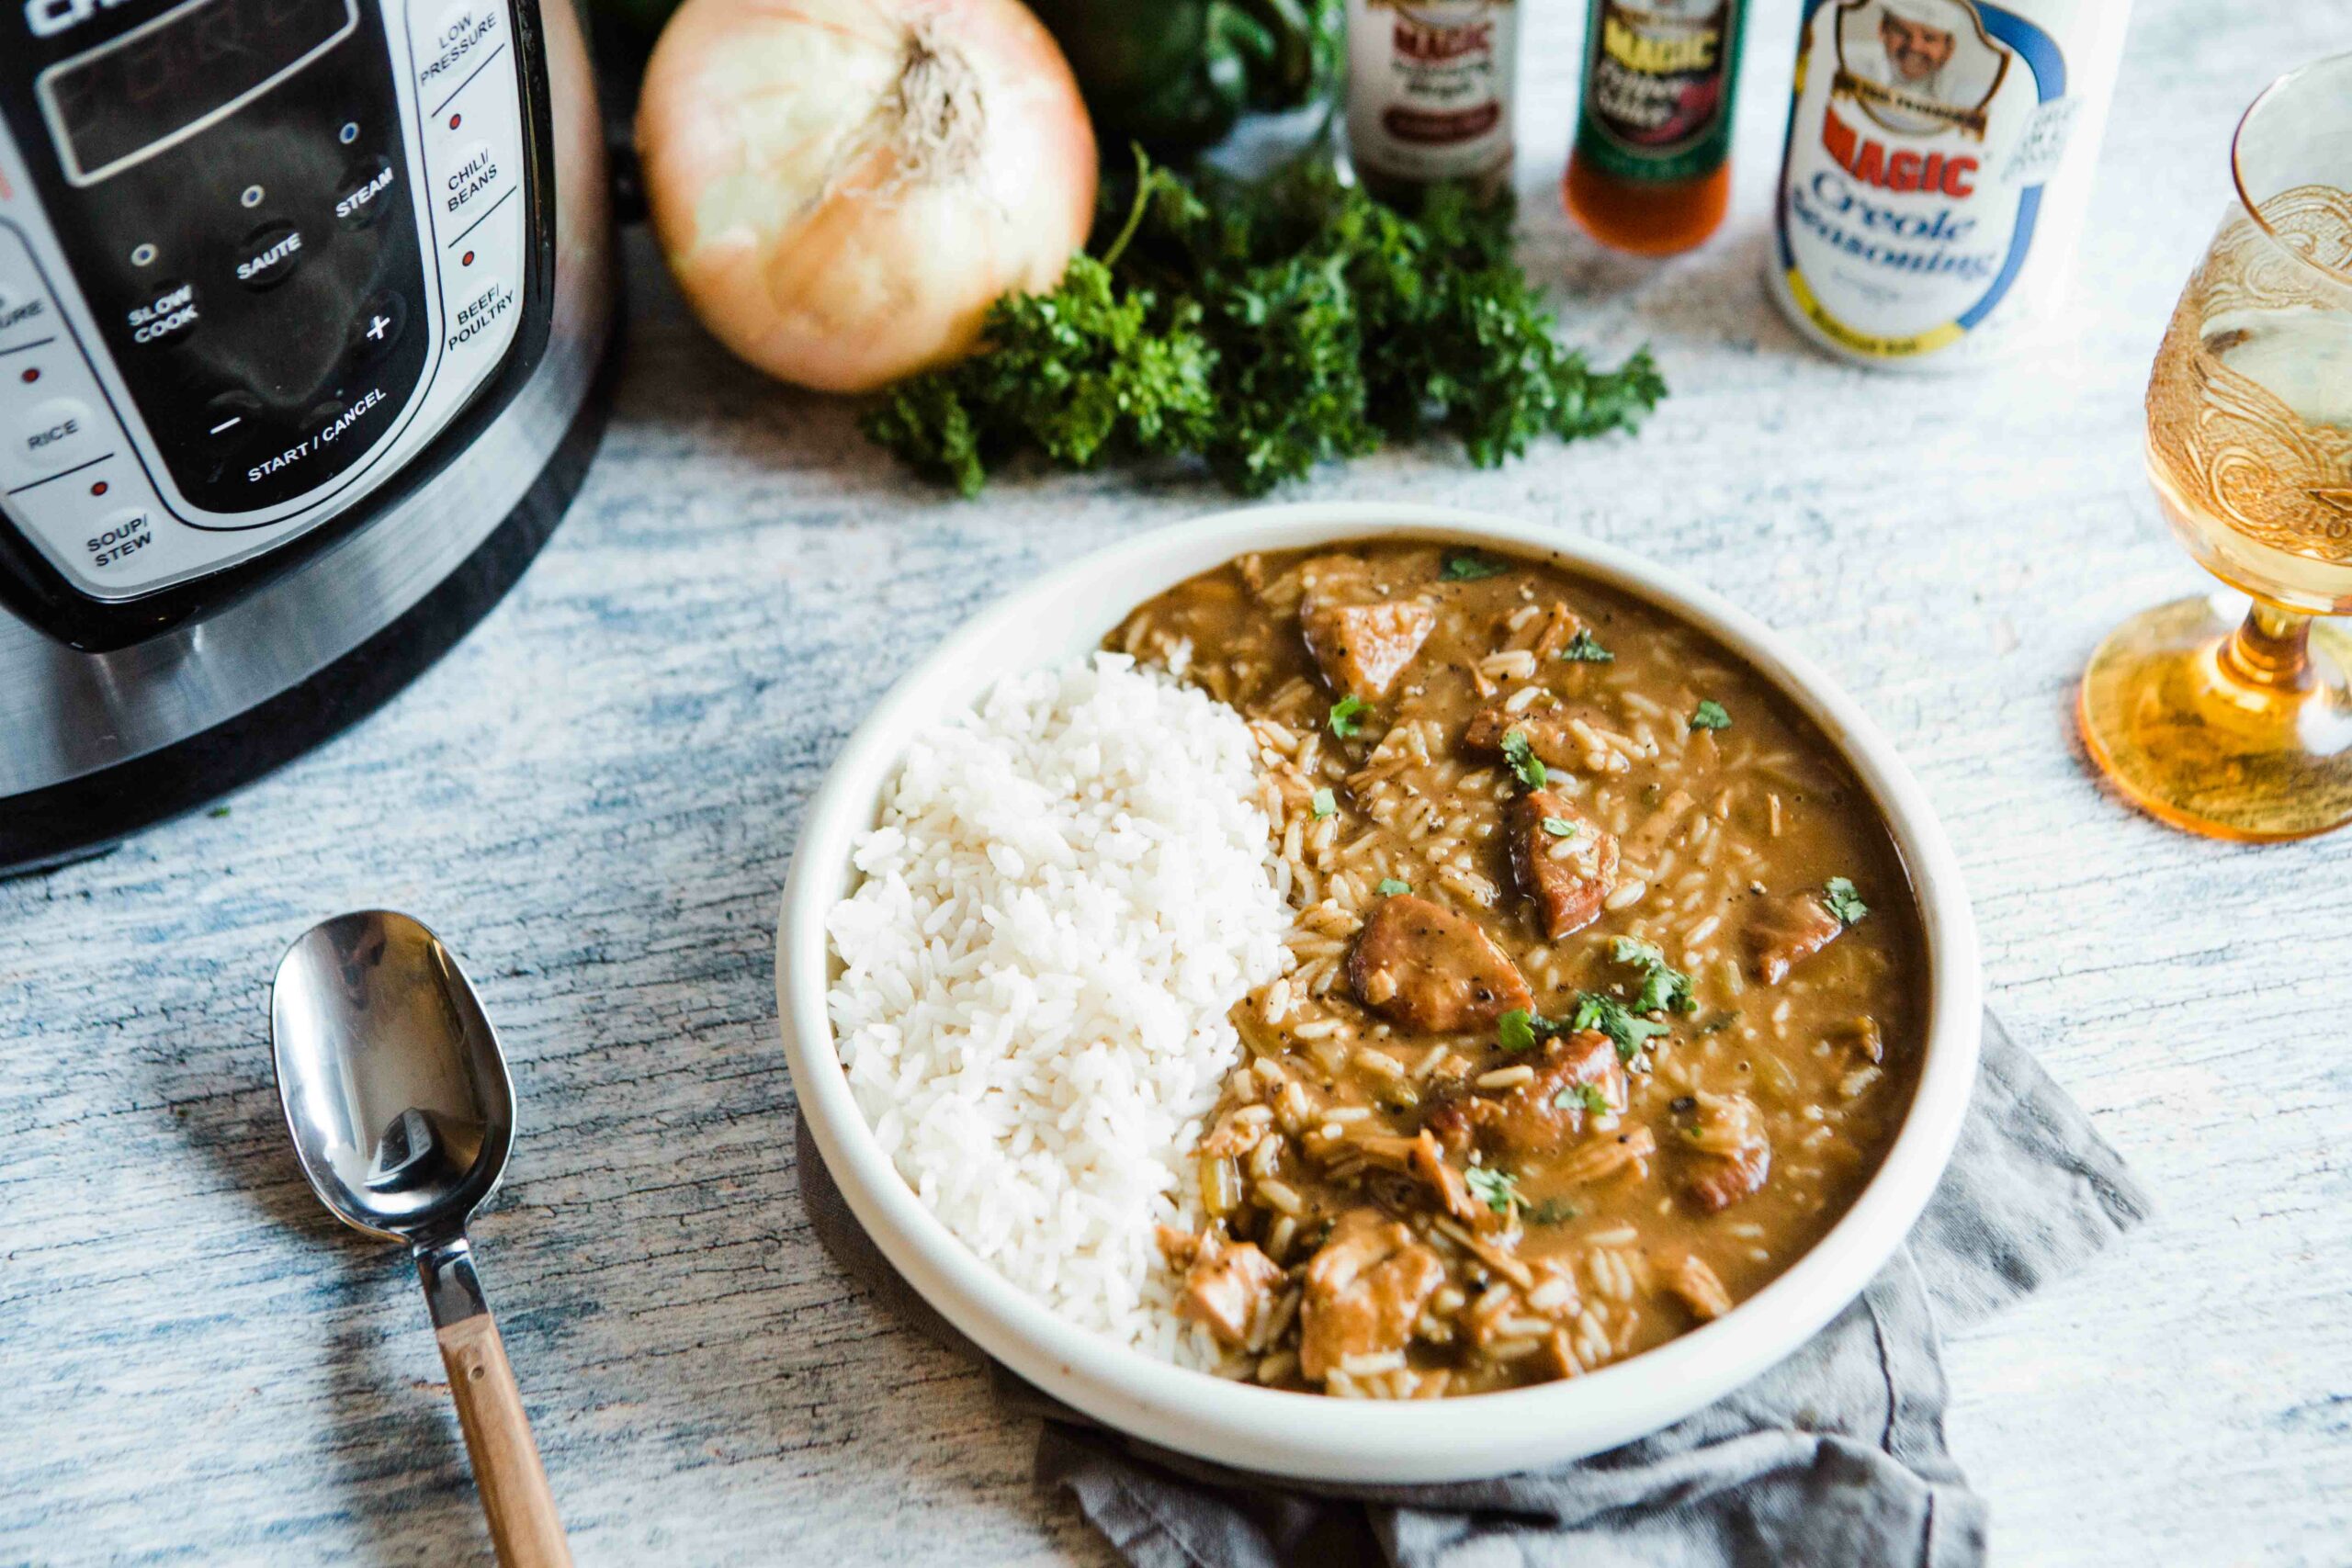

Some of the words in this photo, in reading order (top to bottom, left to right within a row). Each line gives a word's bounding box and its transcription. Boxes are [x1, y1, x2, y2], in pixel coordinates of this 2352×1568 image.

[420, 12, 497, 86] PRESSURE
[438, 12, 472, 49] LOW
[1605, 17, 1718, 74] MAGIC
[447, 147, 489, 190] CHILI/
[1822, 107, 1980, 198] MAGIC
[335, 166, 394, 218] STEAM
[447, 164, 497, 212] BEANS
[1812, 169, 1976, 241] Creole
[236, 231, 302, 280] SAUTE
[128, 284, 192, 326] SLOW
[134, 303, 199, 344] COOK
[448, 289, 514, 351] POULTRY
[458, 283, 500, 325] BEEF/
[28, 419, 79, 450] RICE
[248, 442, 309, 481] START
[313, 435, 319, 449] /
[322, 388, 386, 442] CANCEL
[86, 513, 148, 552] SOUP/
[96, 532, 152, 567] STEW
